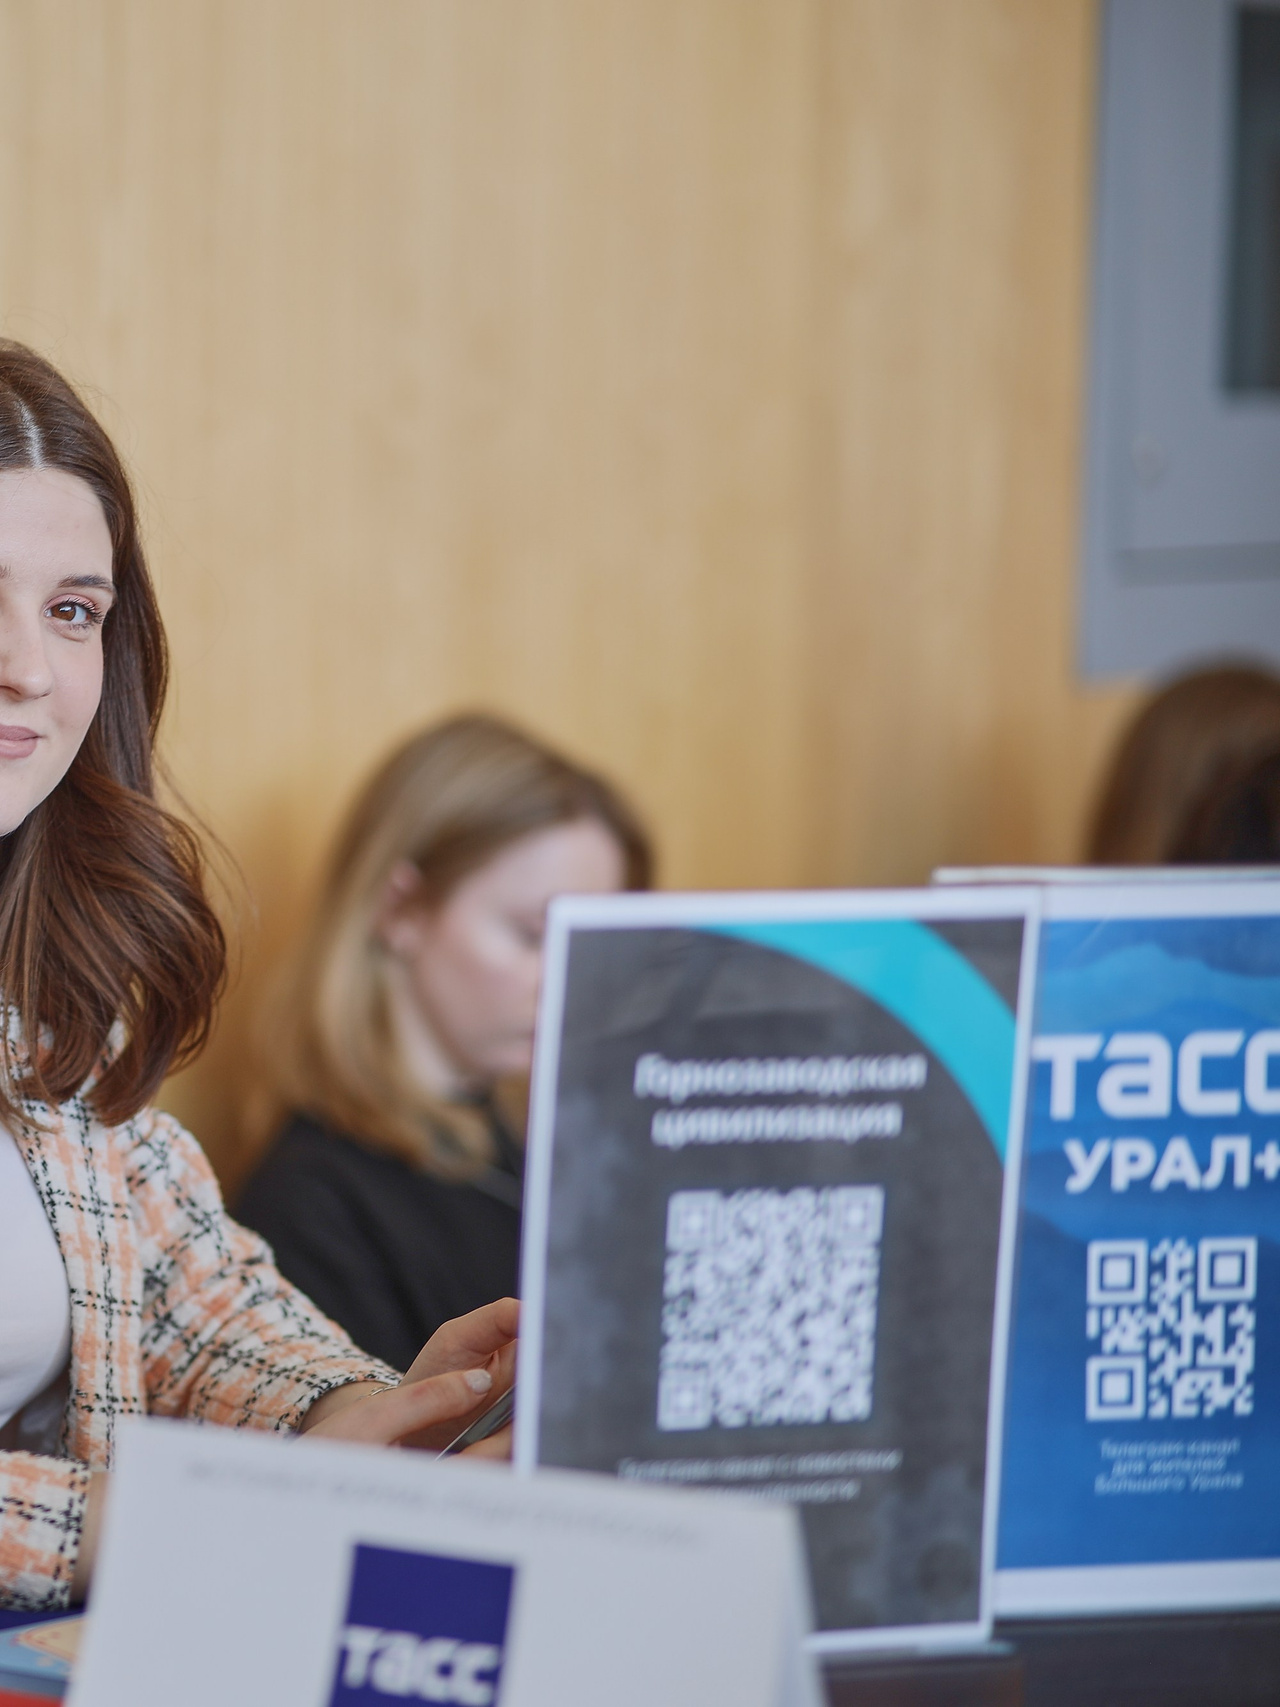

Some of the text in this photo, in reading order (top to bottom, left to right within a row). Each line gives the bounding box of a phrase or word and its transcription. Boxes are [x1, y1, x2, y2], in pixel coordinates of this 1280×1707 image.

[634, 1054, 927, 1102] Горнозаводская
[652, 1104, 901, 1148] цивилизация
[1064, 1135, 1280, 1193] УРАЛ+
